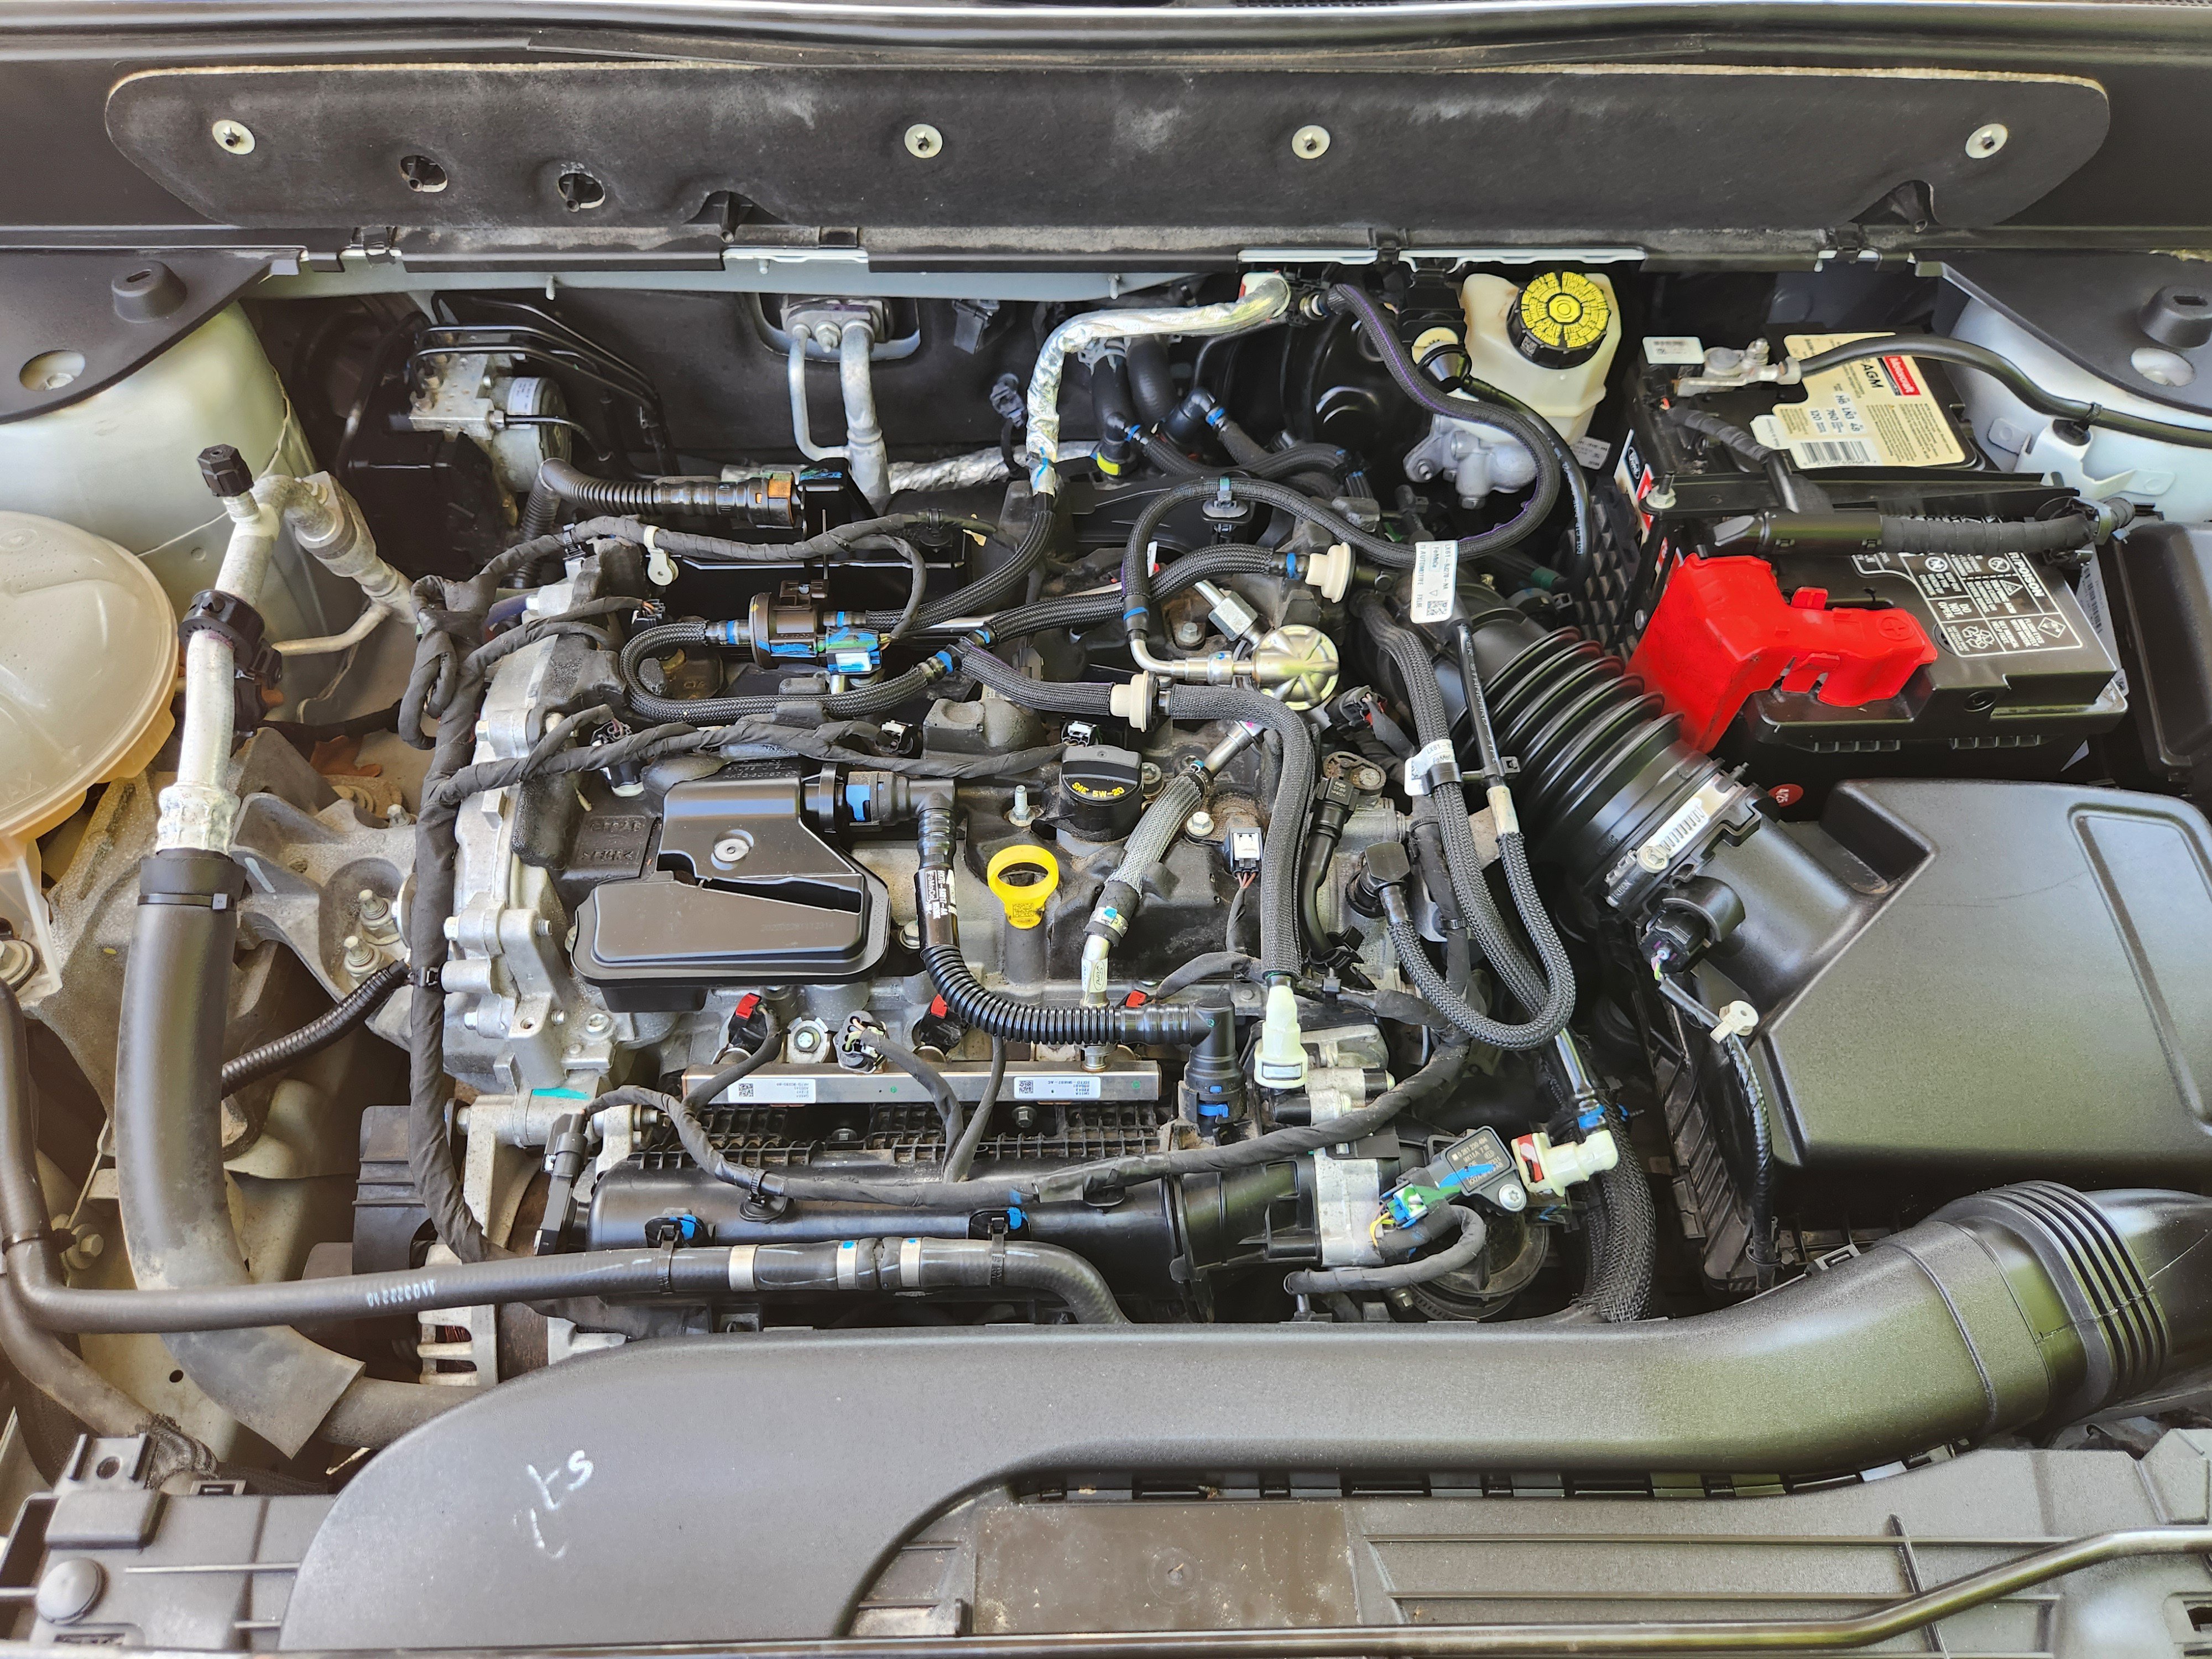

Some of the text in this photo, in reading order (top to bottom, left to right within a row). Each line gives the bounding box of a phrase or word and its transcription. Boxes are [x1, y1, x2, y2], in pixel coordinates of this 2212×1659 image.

[1860, 363, 1884, 388] AGM
[1888, 357, 1915, 393] Motorcraft
[1810, 410, 1822, 420] 120
[1417, 550, 1427, 586] AUTOMOTIVE
[1936, 601, 1955, 619] OPEN.
[1947, 602, 1964, 615] NOT
[1959, 603, 1973, 613] DO
[1071, 781, 1125, 798] SAE 5W-20
[927, 870, 936, 901] FoMoCo
